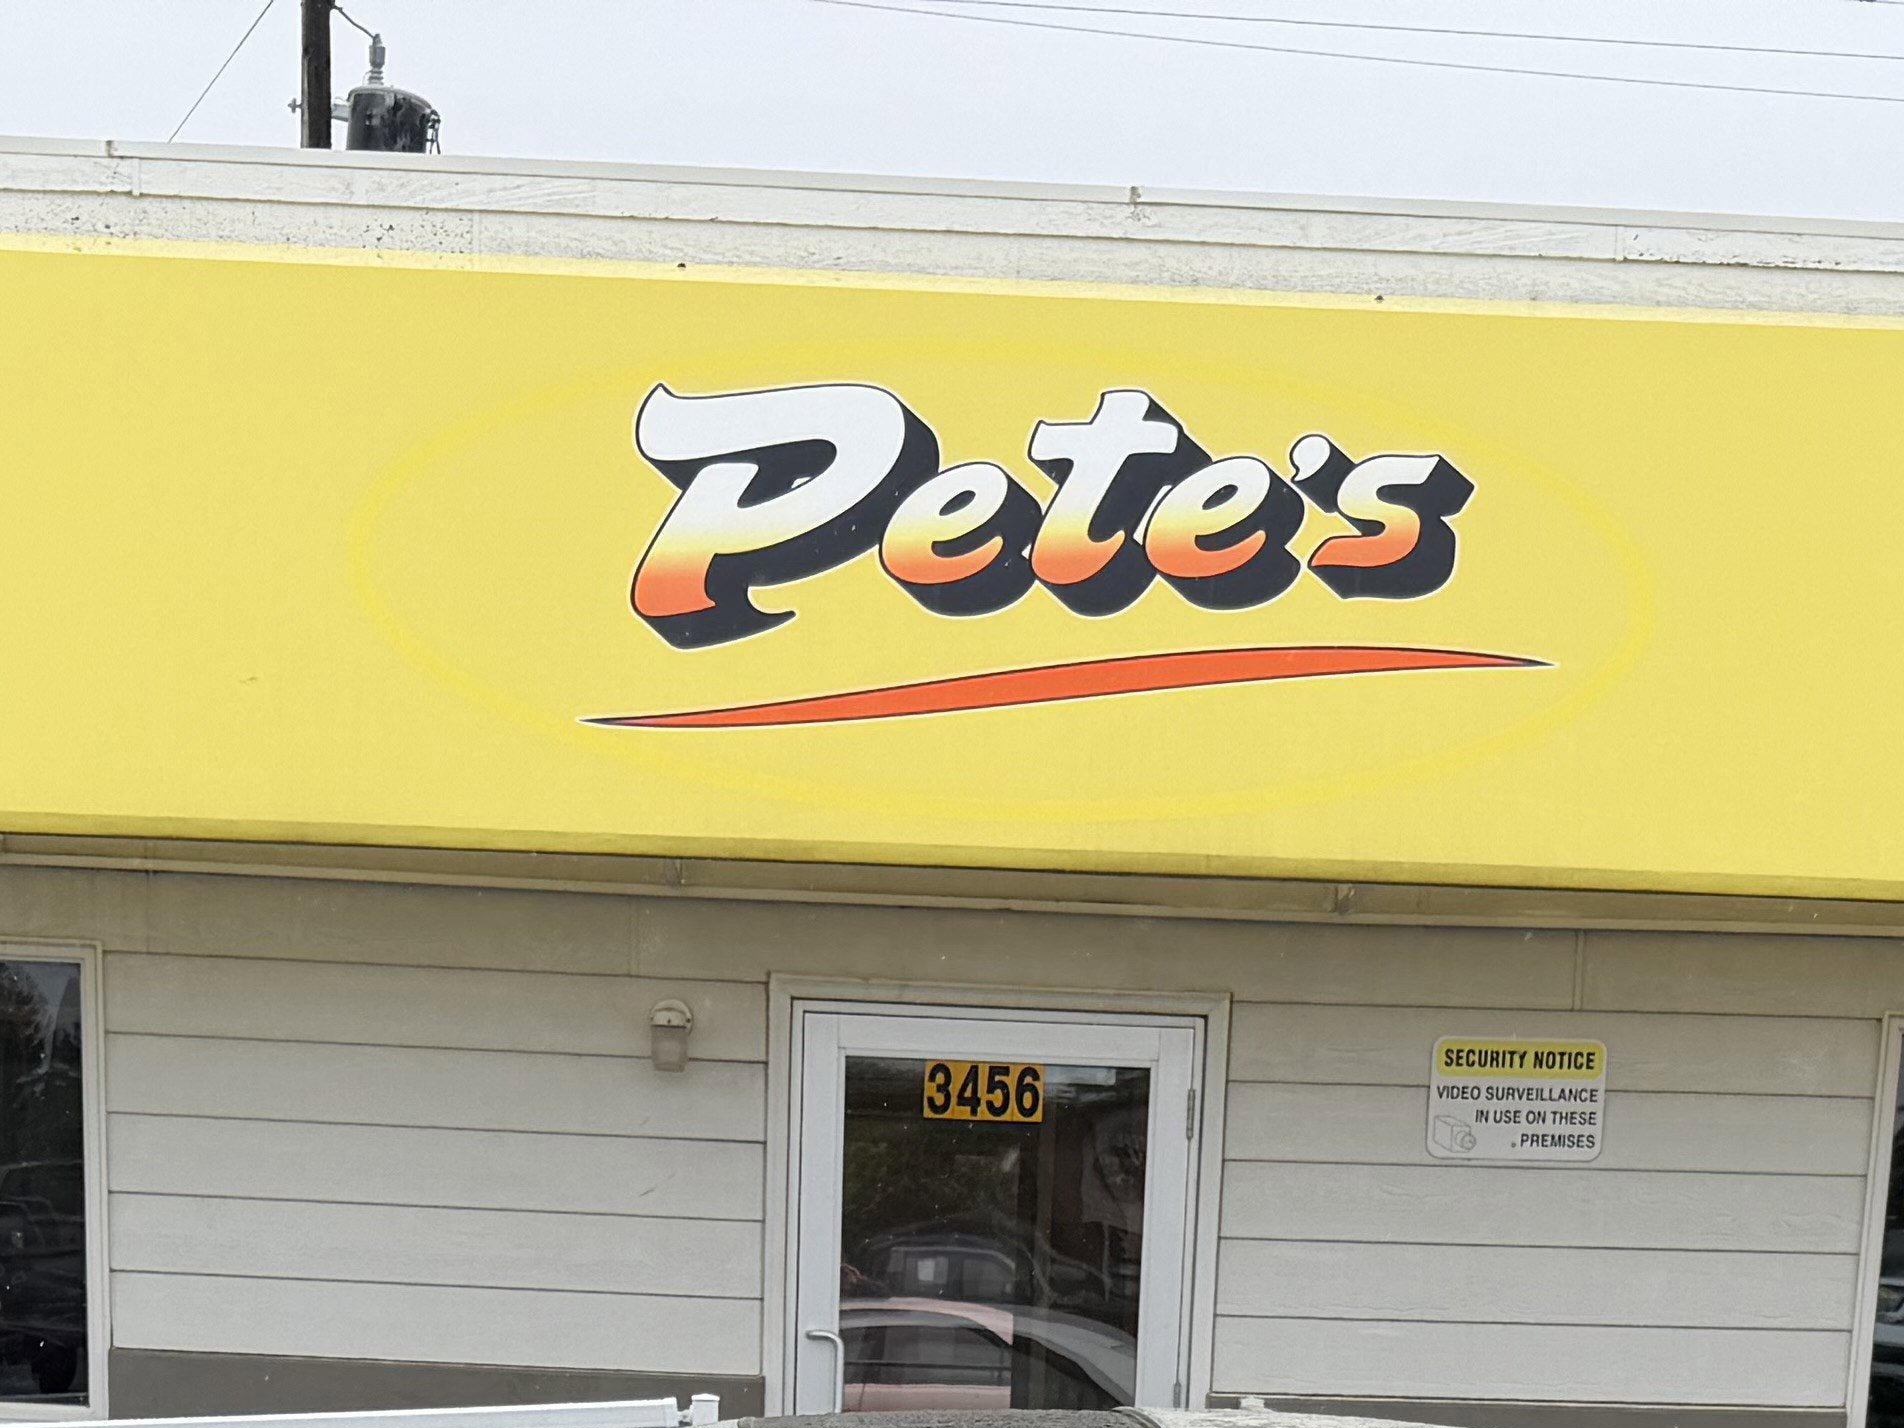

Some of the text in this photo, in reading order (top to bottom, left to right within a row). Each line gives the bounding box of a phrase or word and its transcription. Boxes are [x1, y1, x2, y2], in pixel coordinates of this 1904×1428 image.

[631, 382, 1476, 650] Pete's
[1444, 1048, 1596, 1070] SECURITY NOTICE
[926, 1063, 1040, 1118] 3456
[1437, 1085, 1599, 1103] VIDEO SURVEILLANCE
[1475, 1110, 1597, 1126] IN USE ON THESE
[1520, 1133, 1596, 1149] PREMISES
